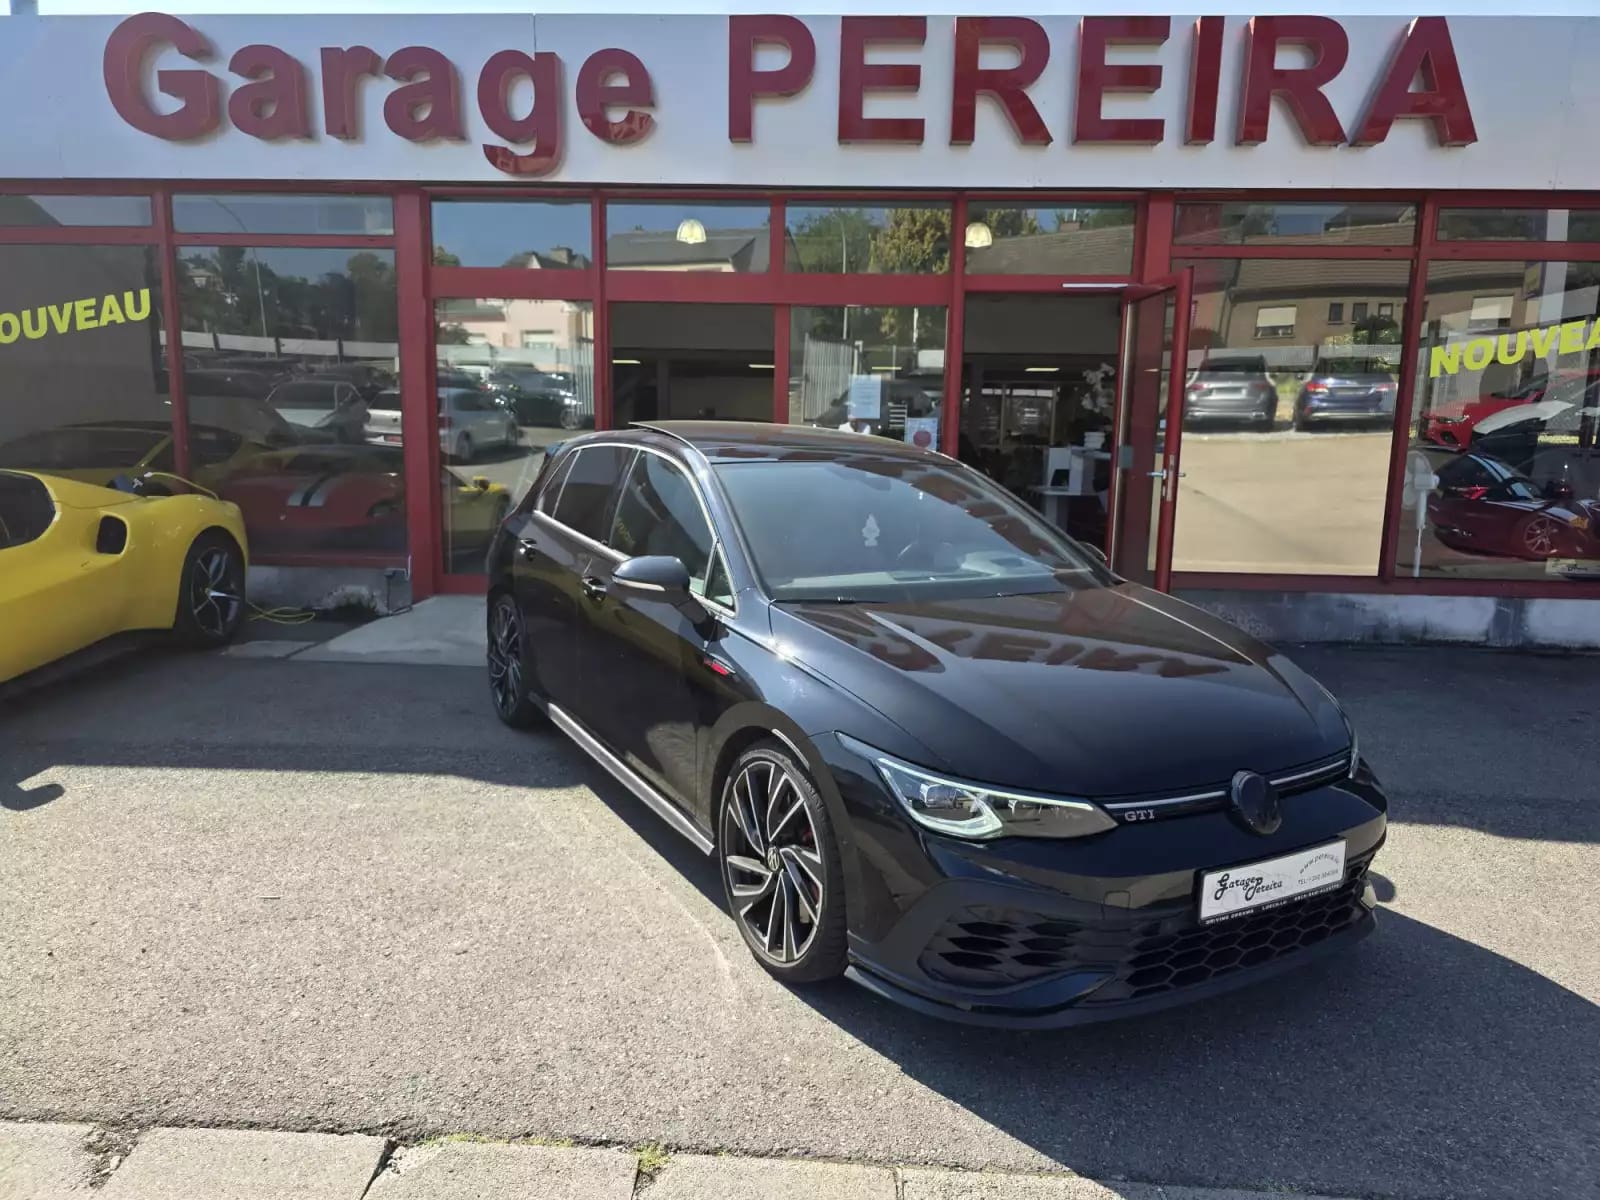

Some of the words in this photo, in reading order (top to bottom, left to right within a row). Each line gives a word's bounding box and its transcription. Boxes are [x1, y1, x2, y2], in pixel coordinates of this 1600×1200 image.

[103, 11, 656, 177] Garage
[728, 15, 1478, 148] PEREIRA
[1124, 809, 1156, 822] GTI
[1214, 873, 1256, 901] Garage
[1244, 876, 1283, 902] Pereira
